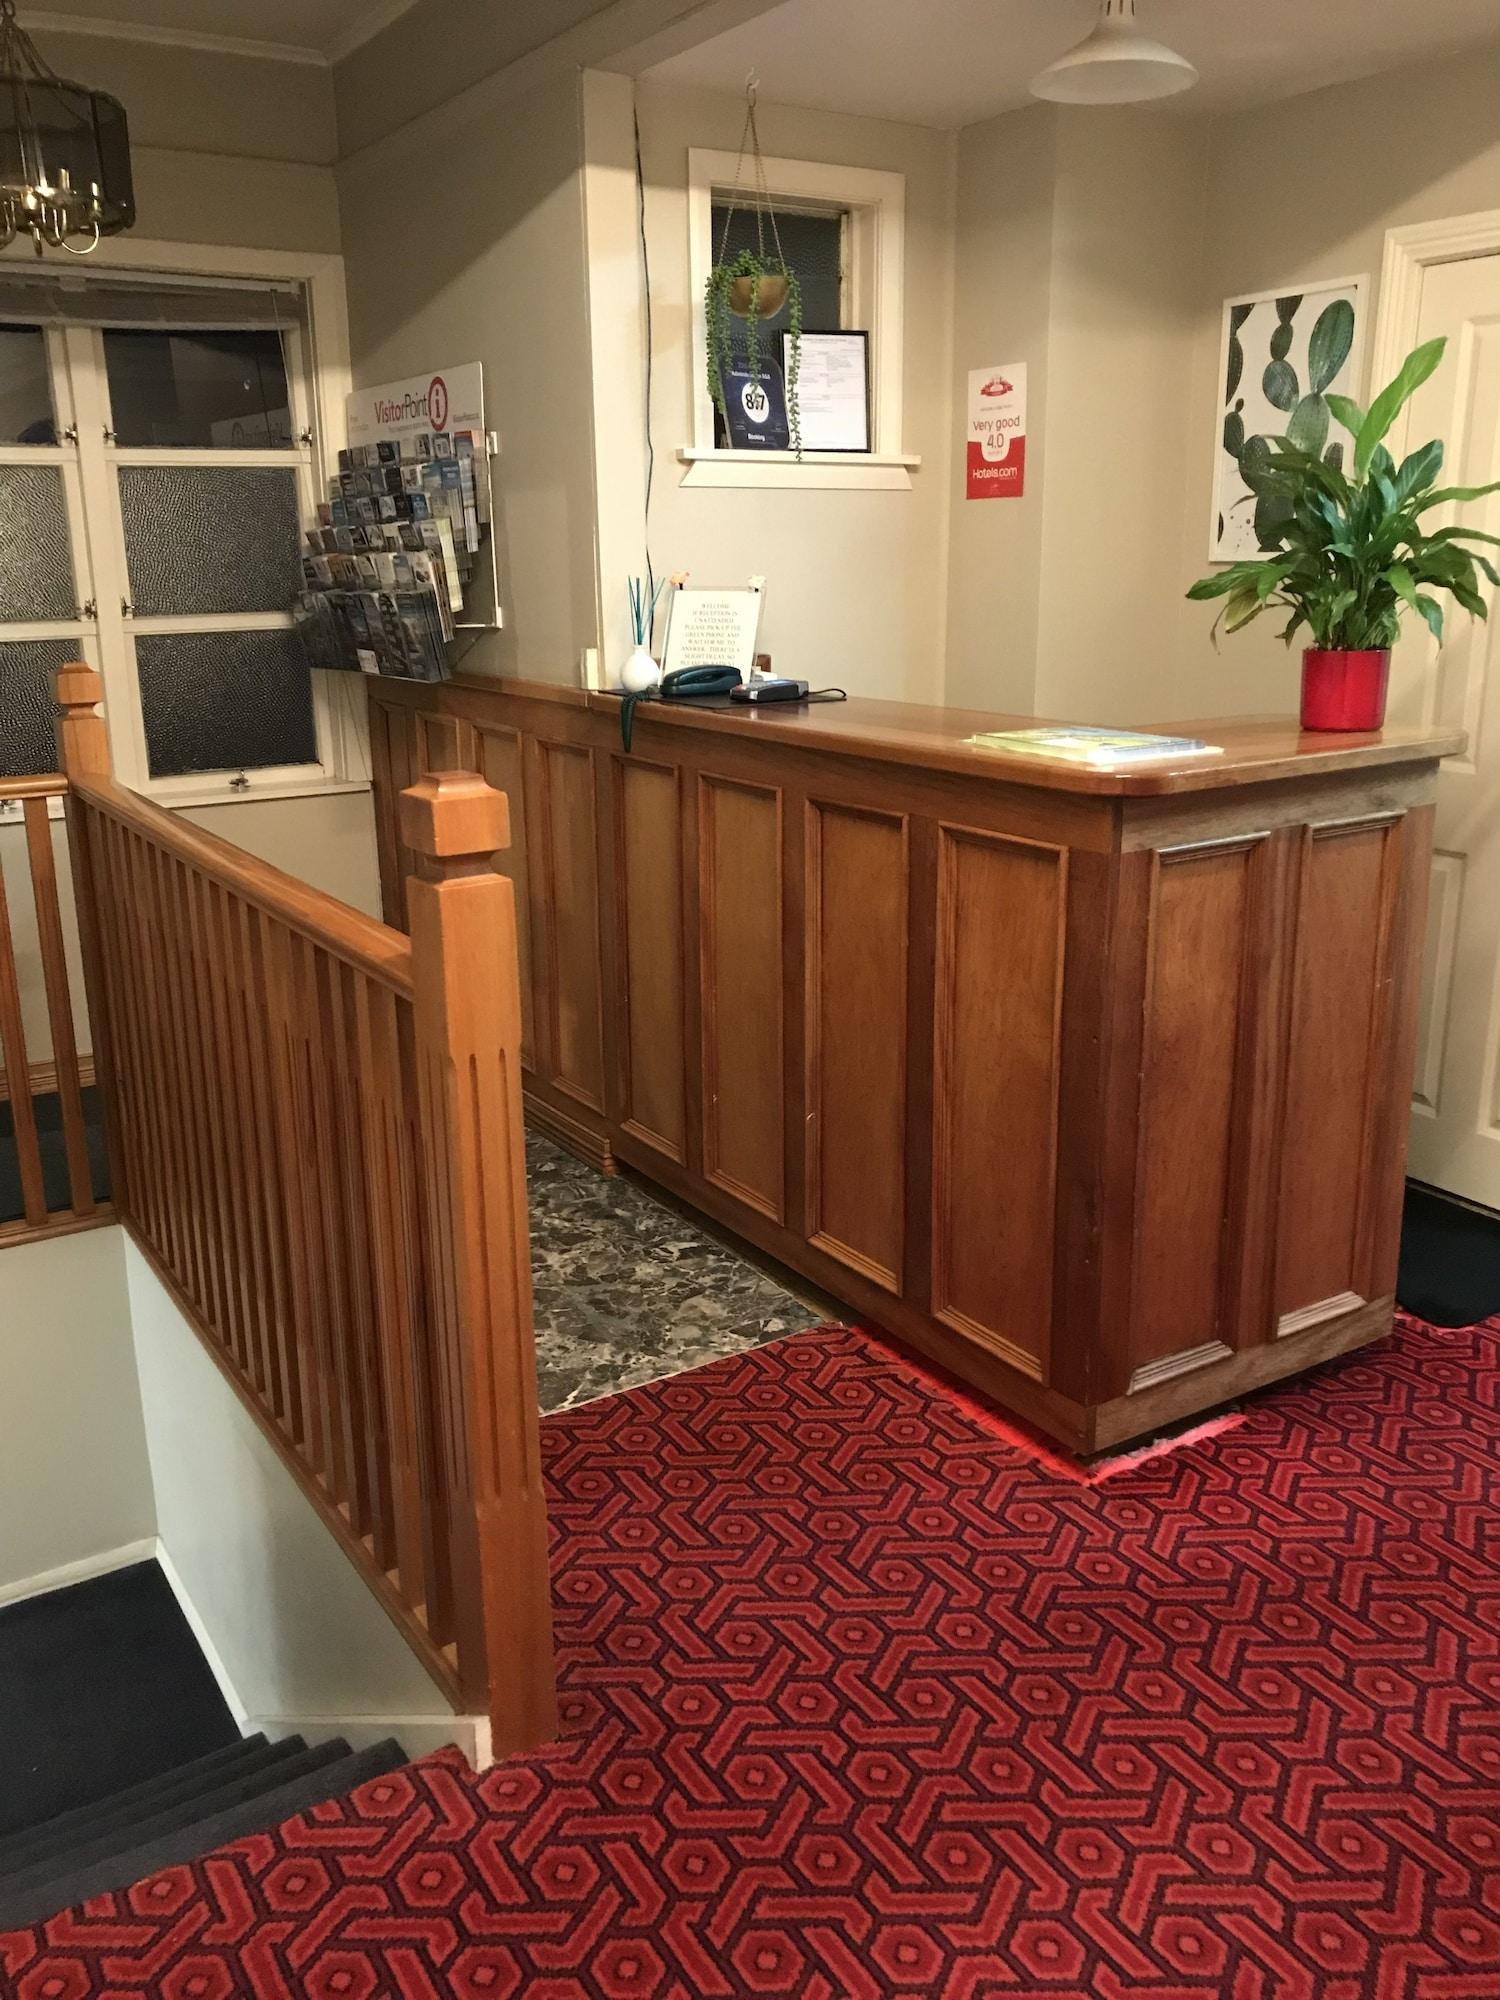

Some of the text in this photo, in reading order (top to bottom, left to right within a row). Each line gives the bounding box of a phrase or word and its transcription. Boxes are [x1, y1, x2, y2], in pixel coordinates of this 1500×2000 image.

[374, 392, 428, 423] VisitorPoint
[995, 415, 1019, 431] good
[987, 433, 1004, 448] 4.0
[972, 467, 1017, 479] Hotels.com
